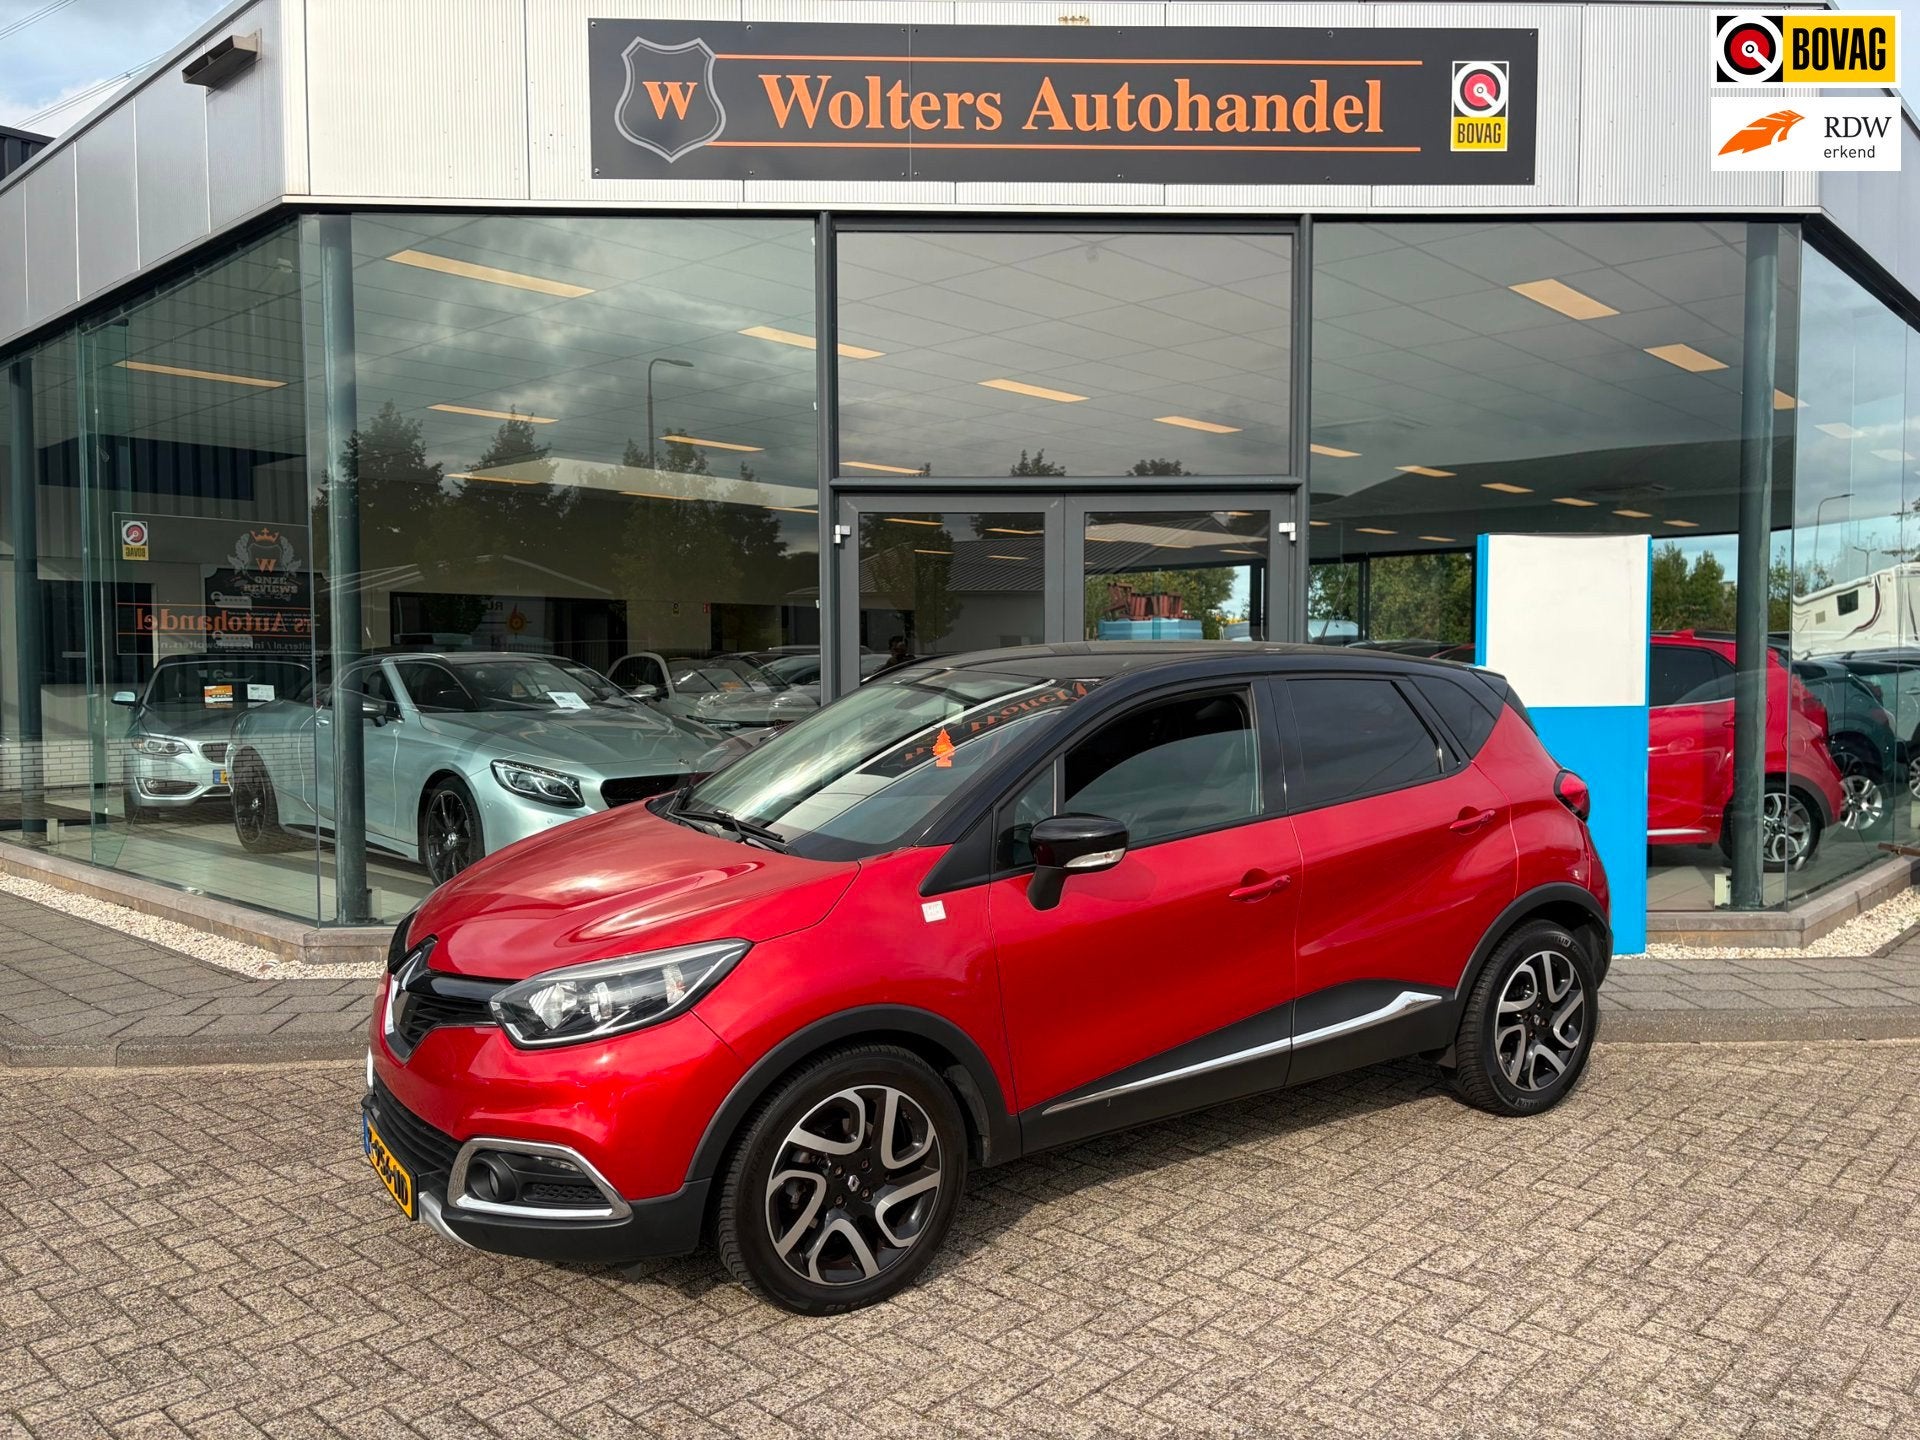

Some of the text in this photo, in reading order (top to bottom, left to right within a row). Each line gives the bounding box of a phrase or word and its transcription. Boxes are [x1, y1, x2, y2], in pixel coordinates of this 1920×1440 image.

[642, 81, 698, 121] W
[758, 74, 1384, 134] Wolters Autohandel
[1457, 123, 1502, 144] BOVAG
[243, 584, 298, 594] REVIEWS
